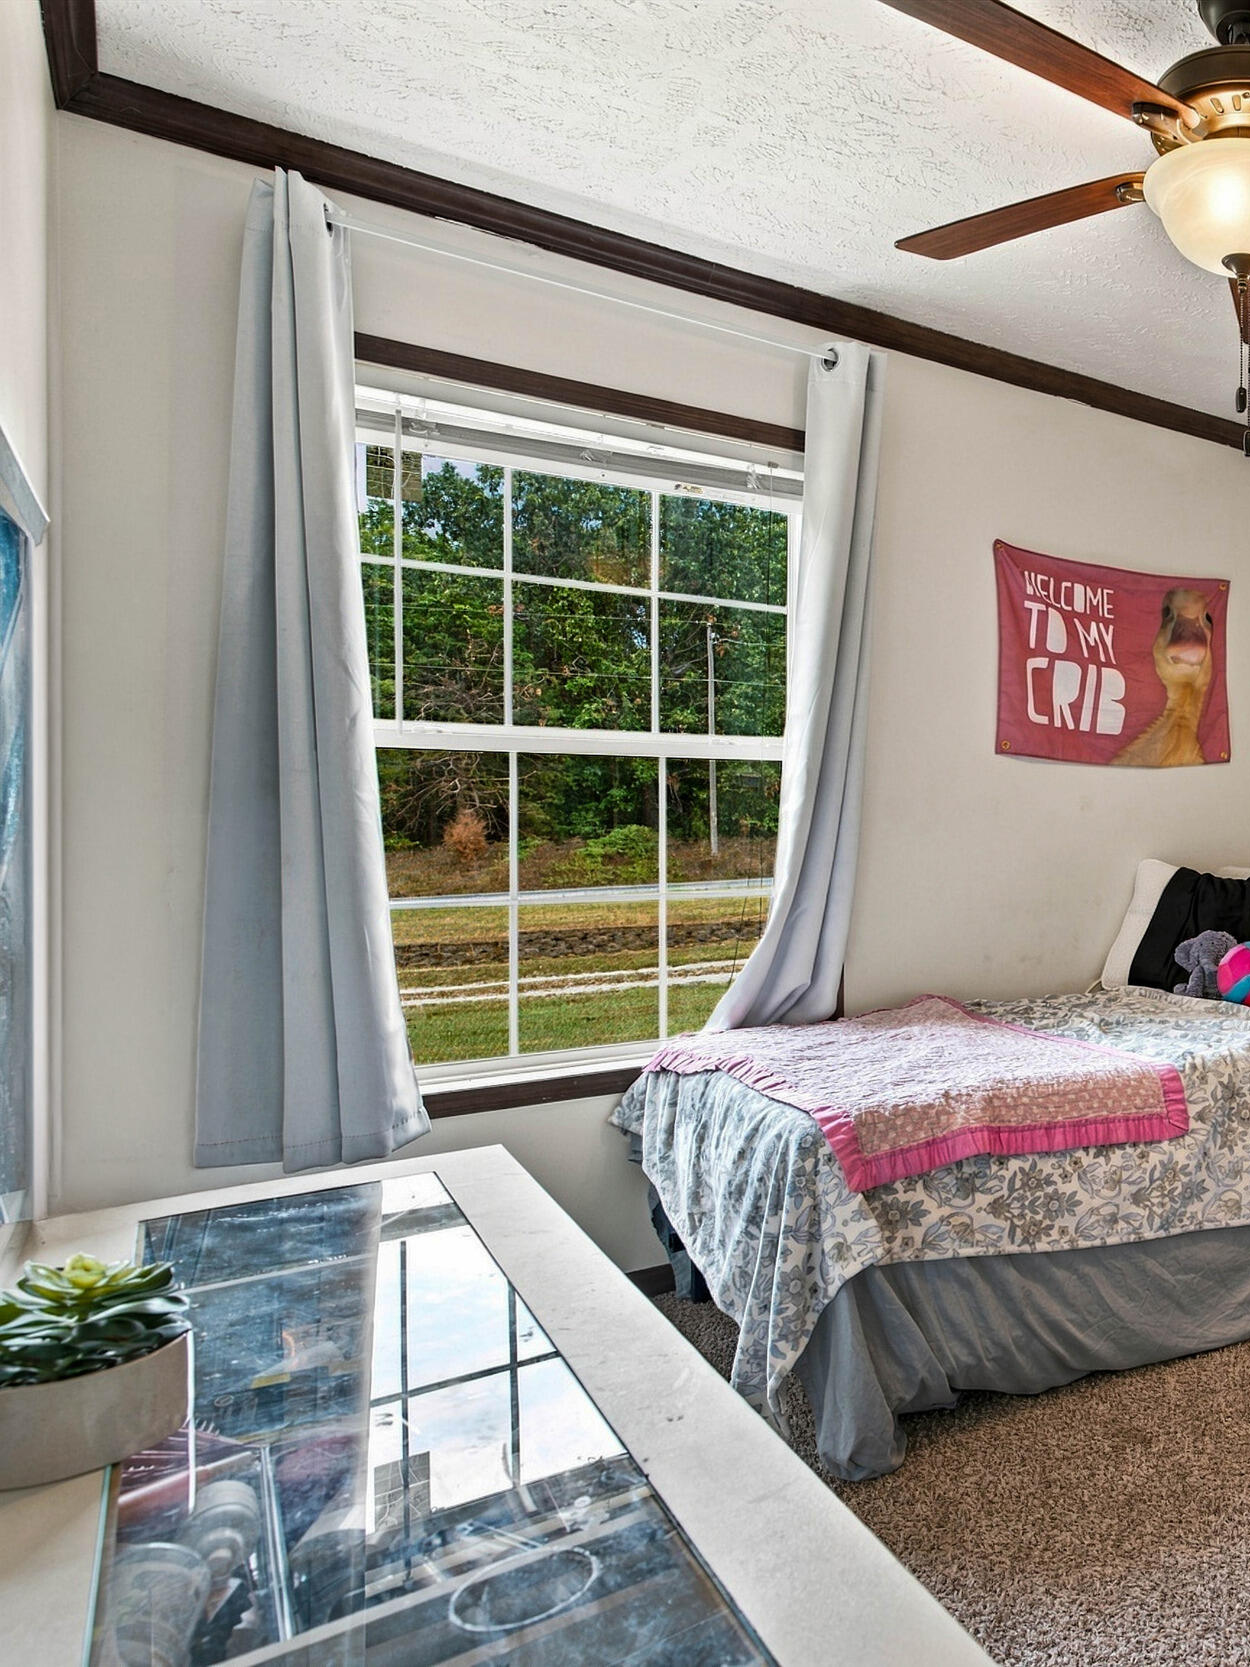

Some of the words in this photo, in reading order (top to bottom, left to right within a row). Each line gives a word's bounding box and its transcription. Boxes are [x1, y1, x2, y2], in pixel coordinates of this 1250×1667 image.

[1024, 572, 1114, 618] WELCOME
[1024, 601, 1067, 654] TO
[1073, 617, 1117, 664] MY
[1026, 657, 1125, 734] CRIB
